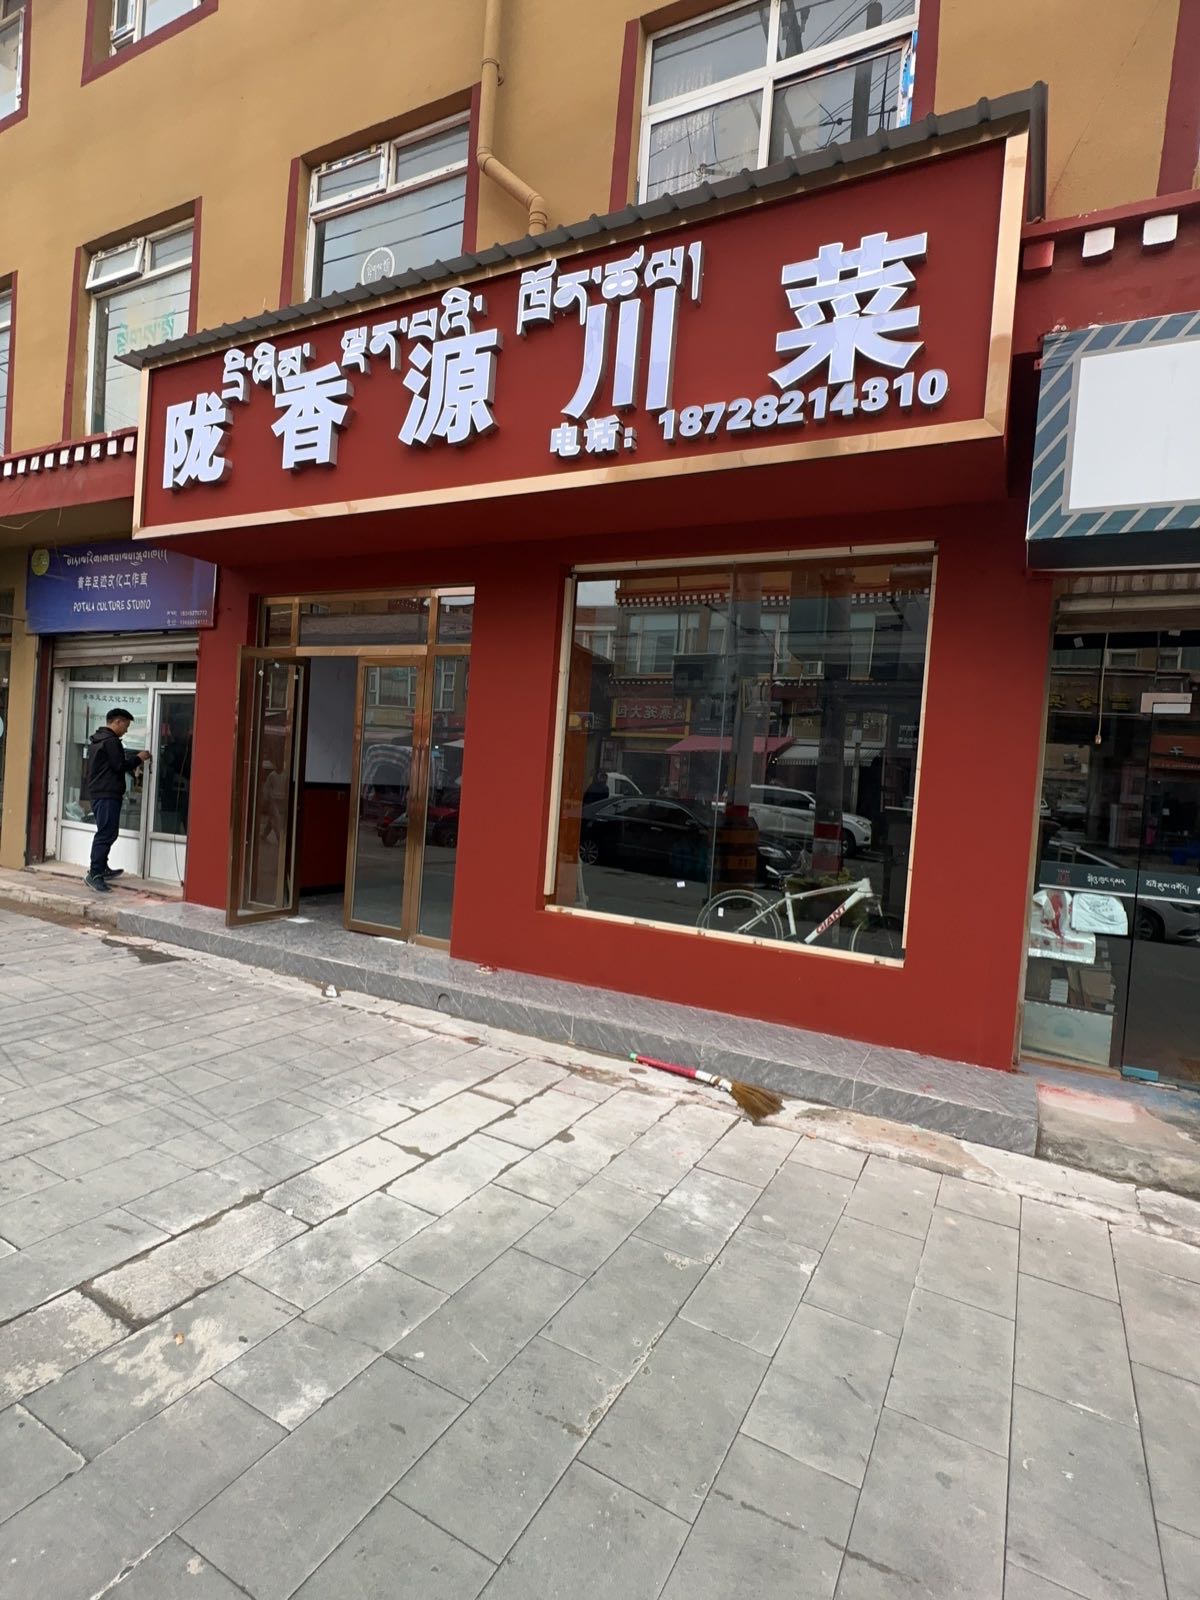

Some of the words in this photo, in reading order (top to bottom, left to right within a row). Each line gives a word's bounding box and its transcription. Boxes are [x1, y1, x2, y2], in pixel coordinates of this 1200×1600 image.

[163, 232, 928, 490] 陇香源川菜
[658, 369, 949, 440] 18728214310
[77, 572, 149, 591] 青年足迹文化工作室
[73, 600, 95, 613] POTALA
[96, 600, 125, 612] CULTURE
[126, 599, 151, 611] STUDIO
[816, 902, 846, 934] GIANT
